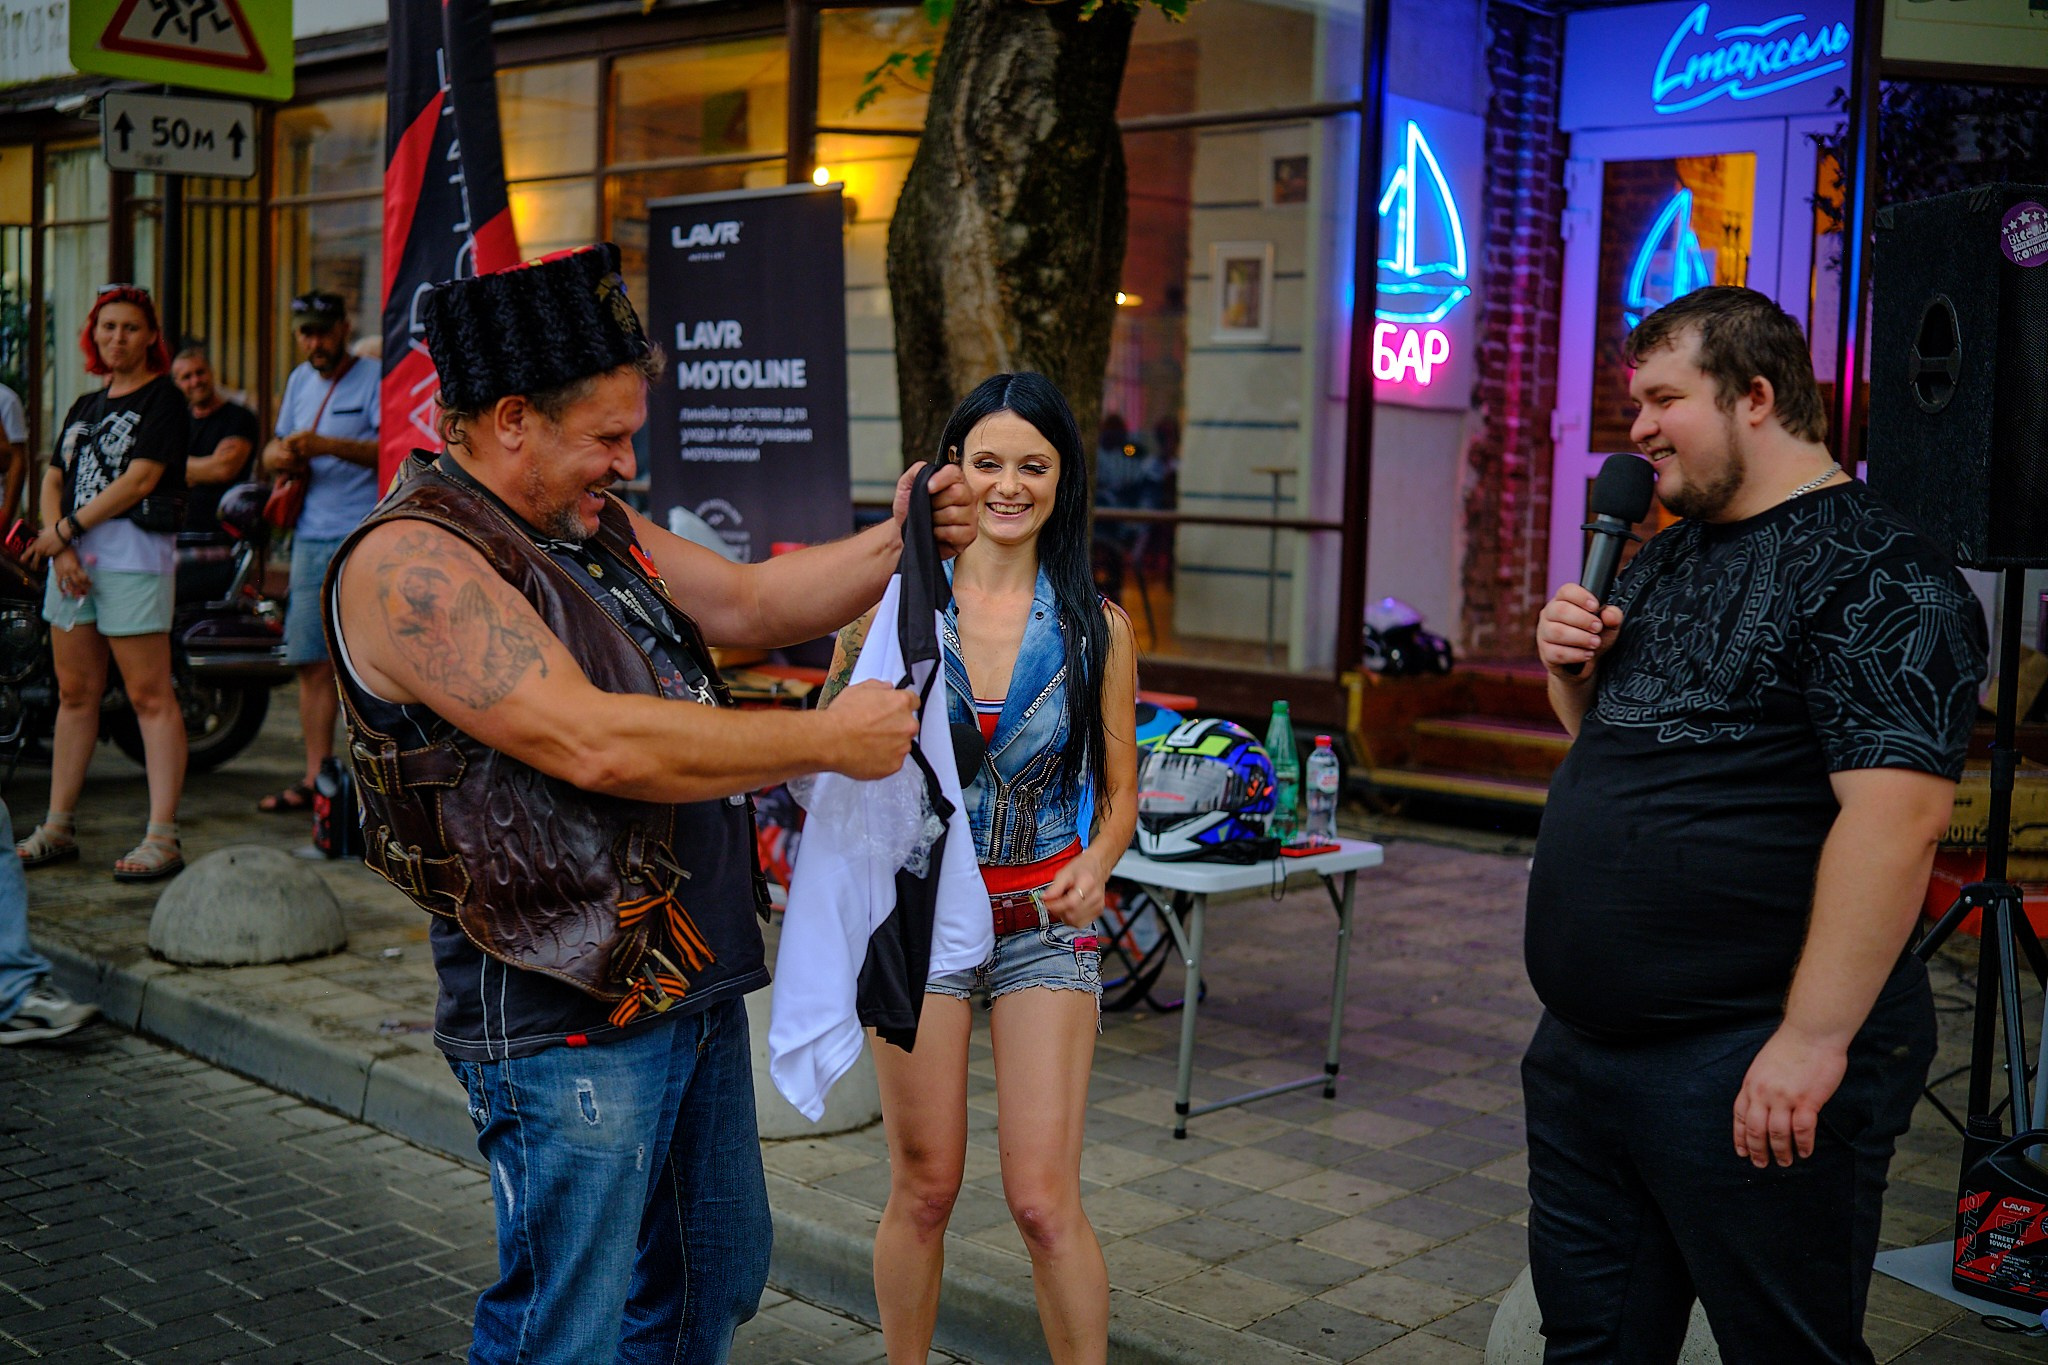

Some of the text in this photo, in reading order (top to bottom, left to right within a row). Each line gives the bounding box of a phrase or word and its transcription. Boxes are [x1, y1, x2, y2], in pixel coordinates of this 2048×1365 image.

[1652, 3, 1851, 101] Стаксель
[671, 220, 741, 248] LAVR
[676, 320, 743, 350] LAVR
[1372, 321, 1450, 386] БАР
[678, 359, 807, 390] MOTOLINE
[2002, 1201, 2031, 1214] LAVR
[1961, 1189, 1980, 1267] MOTO
[1989, 1232, 2015, 1244] STREET
[1996, 1214, 2035, 1237] GT
[1989, 1239, 2012, 1250] 10W40
